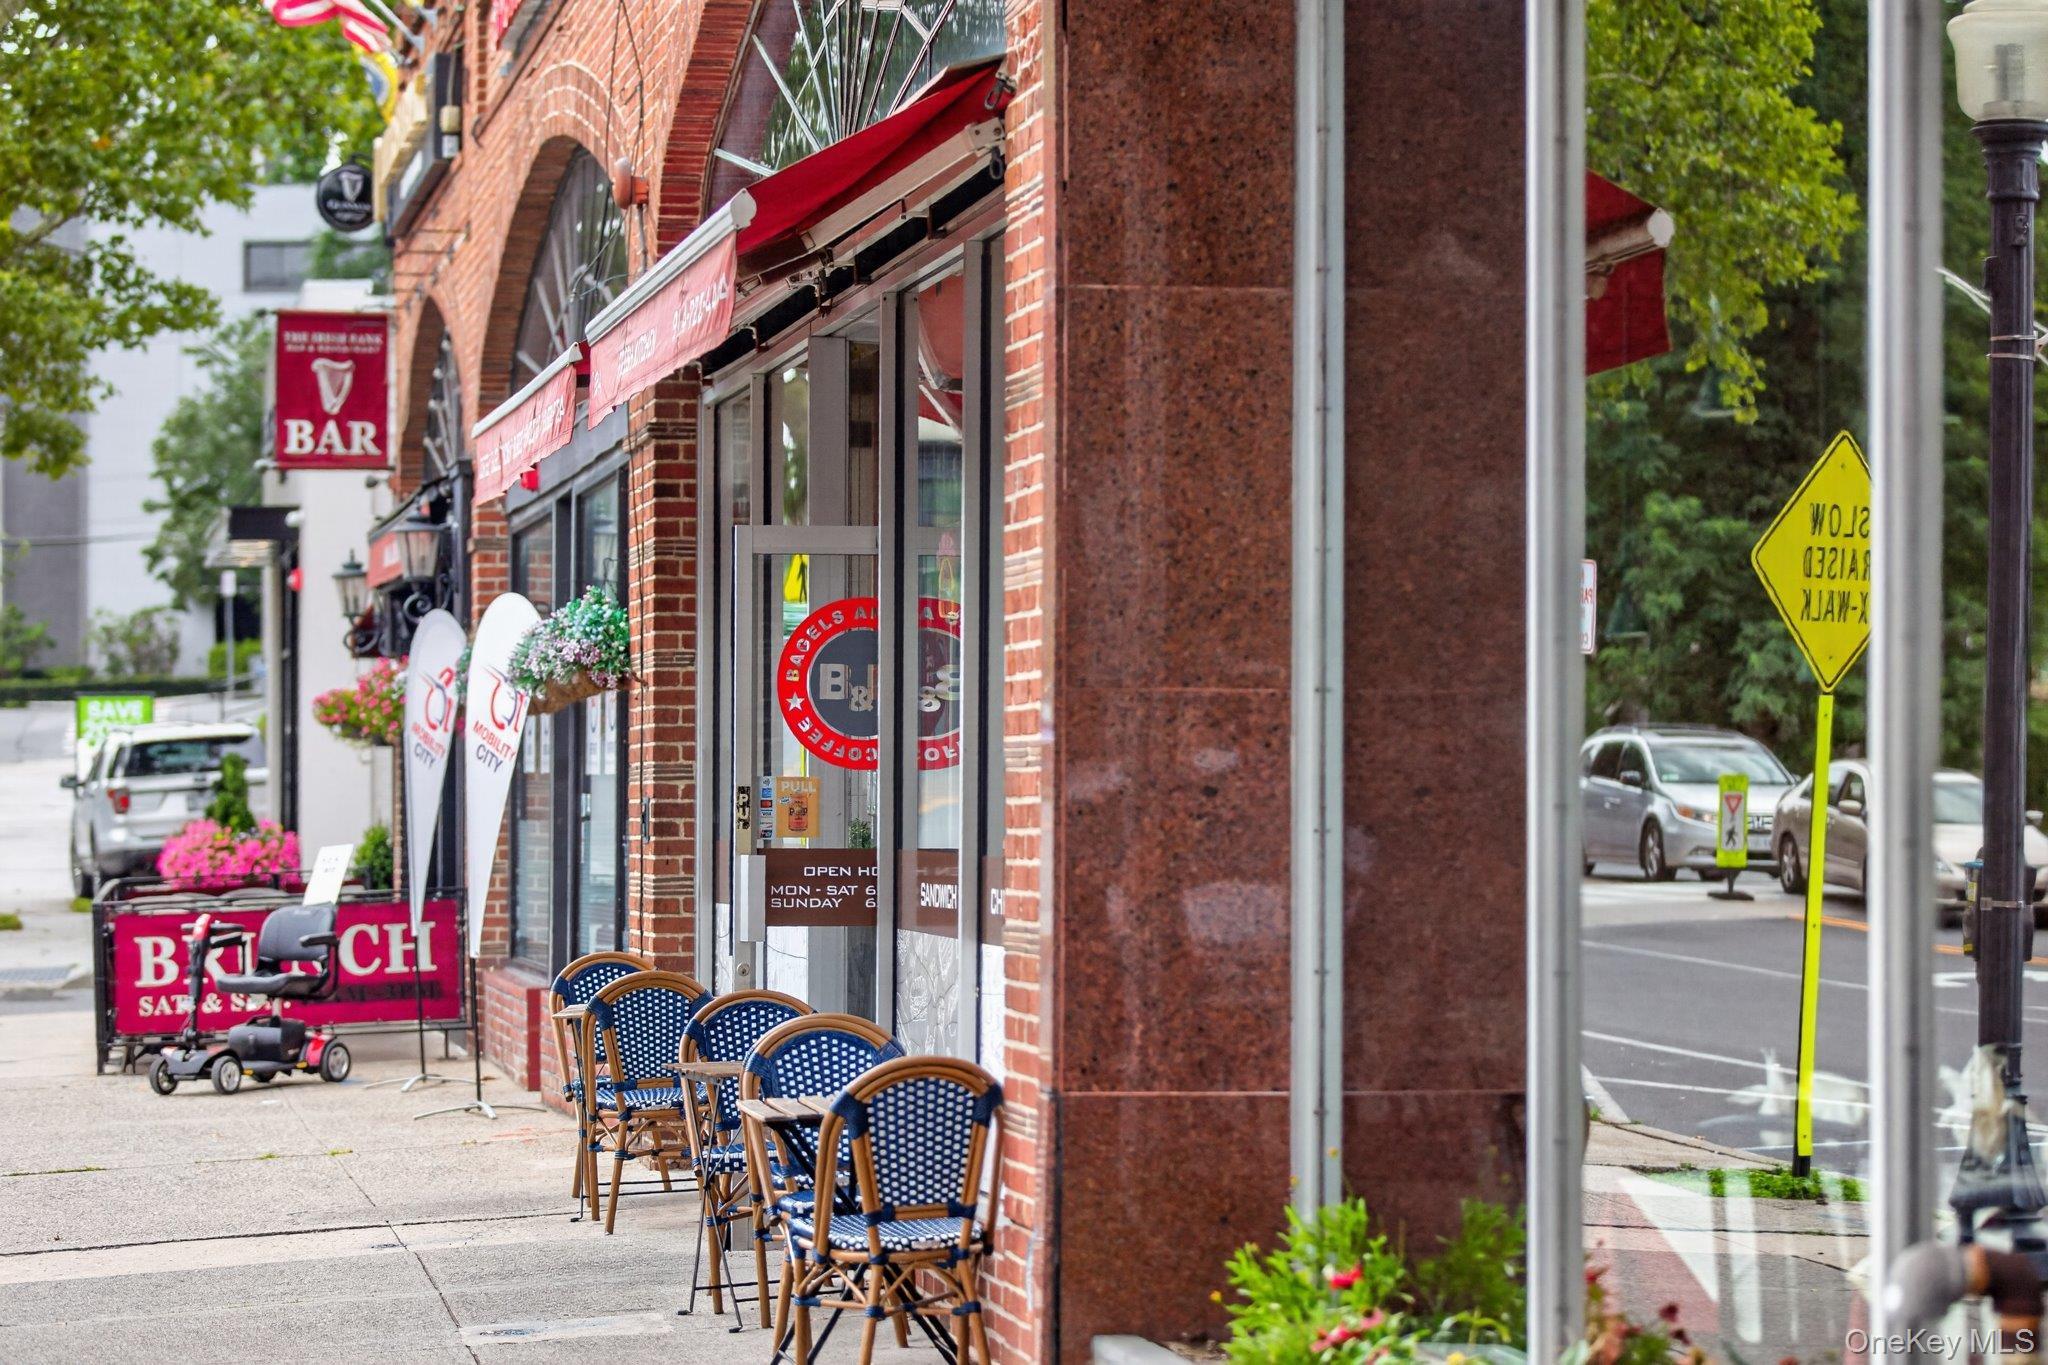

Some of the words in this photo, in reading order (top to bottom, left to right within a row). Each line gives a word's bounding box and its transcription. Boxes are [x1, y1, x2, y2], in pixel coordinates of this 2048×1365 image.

[284, 418, 383, 456] BAR
[785, 610, 845, 682] BAGELS
[473, 720, 516, 761] MOBILITY
[414, 743, 437, 770] CITY
[476, 743, 503, 773] CITY
[804, 866, 851, 877] OPEN
[771, 885, 810, 896] MON
[827, 885, 858, 896] SAT
[771, 897, 842, 908] SUNDAY
[202, 993, 223, 1014] &
